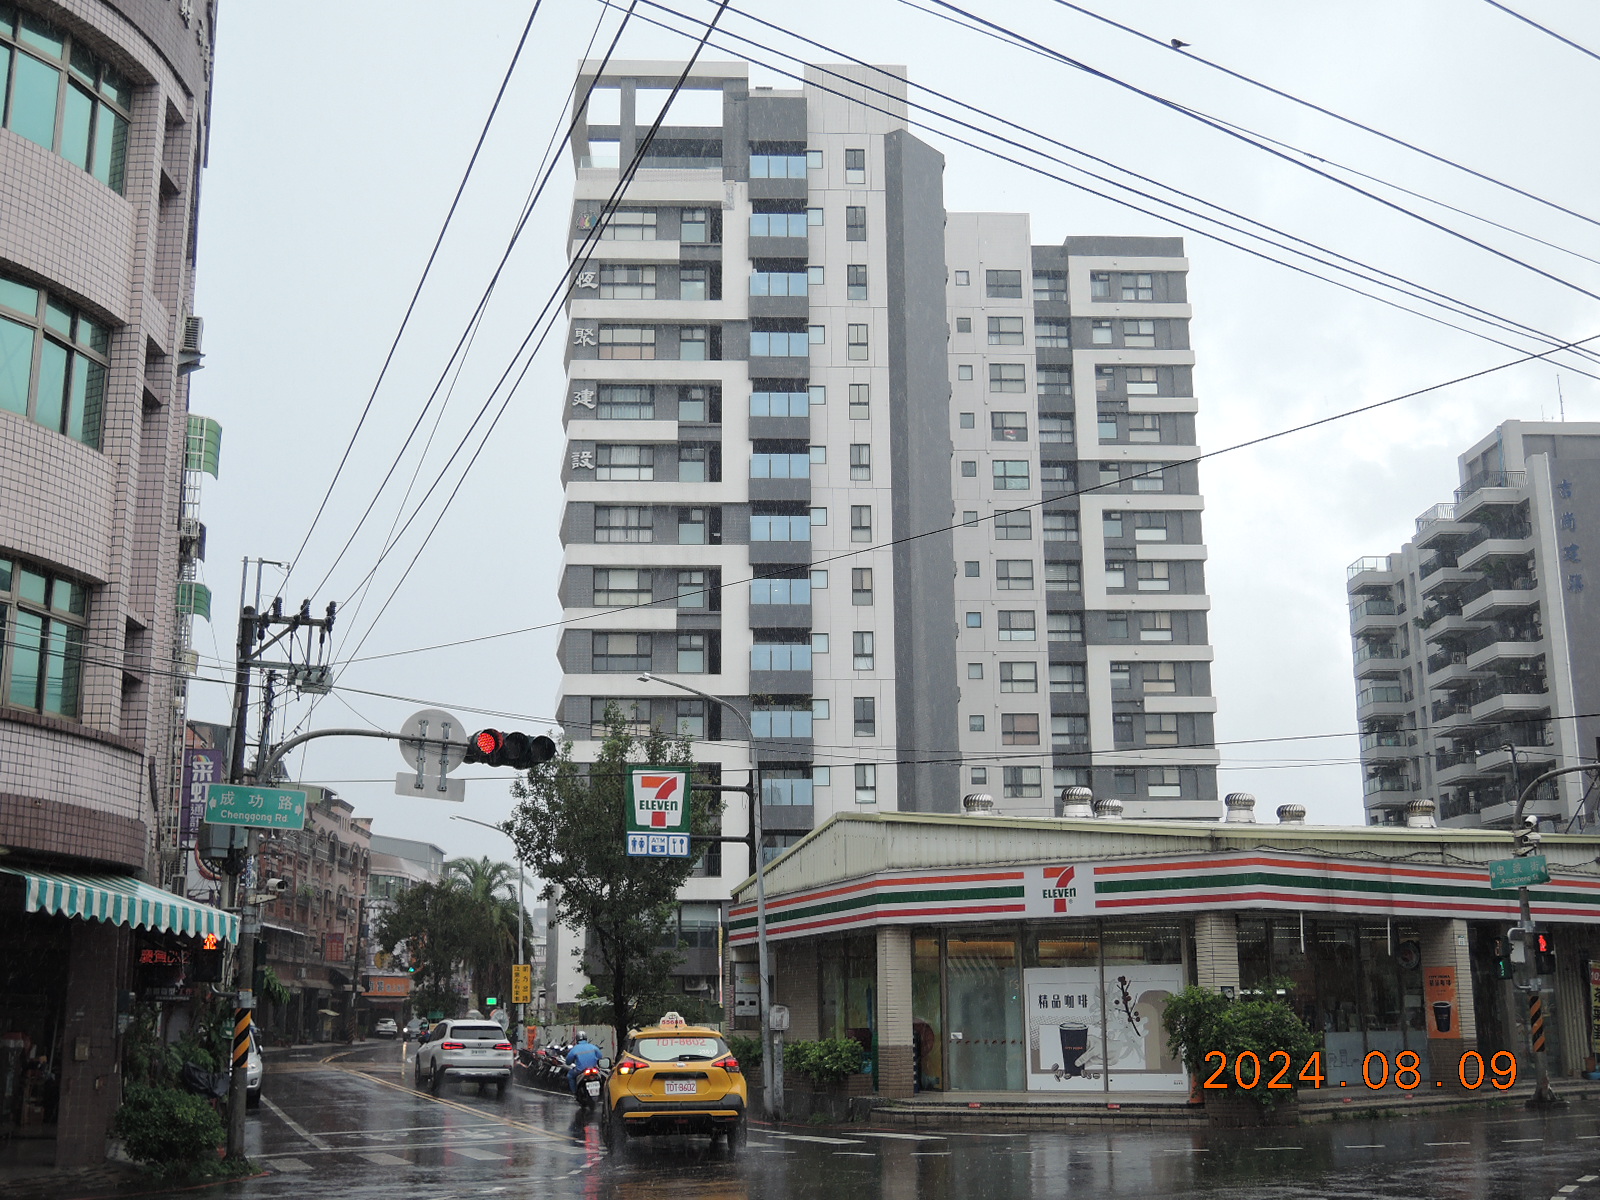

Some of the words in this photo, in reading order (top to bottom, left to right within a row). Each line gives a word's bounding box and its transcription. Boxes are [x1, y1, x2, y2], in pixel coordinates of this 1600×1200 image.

[220, 790, 293, 811] 成功路
[641, 775, 678, 827] 7
[220, 810, 272, 823] Chenggong
[1042, 865, 1075, 912] 7
[1038, 993, 1089, 1010] 精品咖啡
[655, 1037, 707, 1047] TDT-8602
[666, 1083, 696, 1093] TDT-8602
